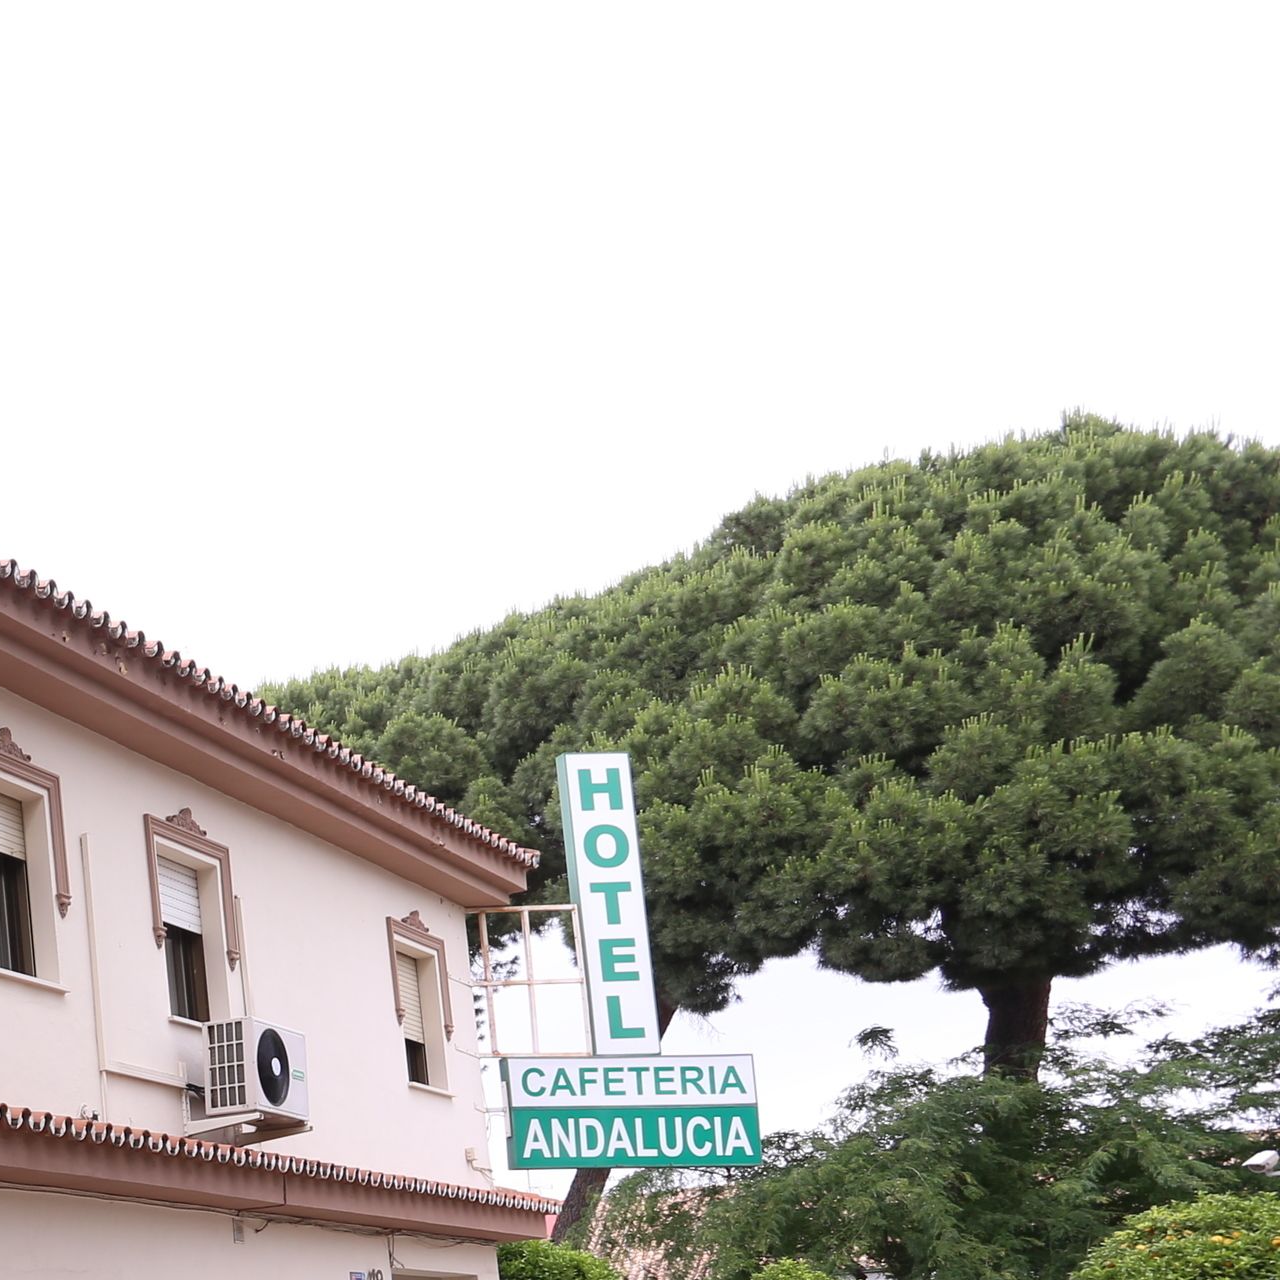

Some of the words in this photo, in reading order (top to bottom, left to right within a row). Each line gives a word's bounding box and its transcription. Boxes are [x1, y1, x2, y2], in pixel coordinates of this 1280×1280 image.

[577, 768, 646, 1039] HOTEL
[520, 1065, 747, 1098] CAFETERIA
[522, 1115, 755, 1159] ANDALUCIA
